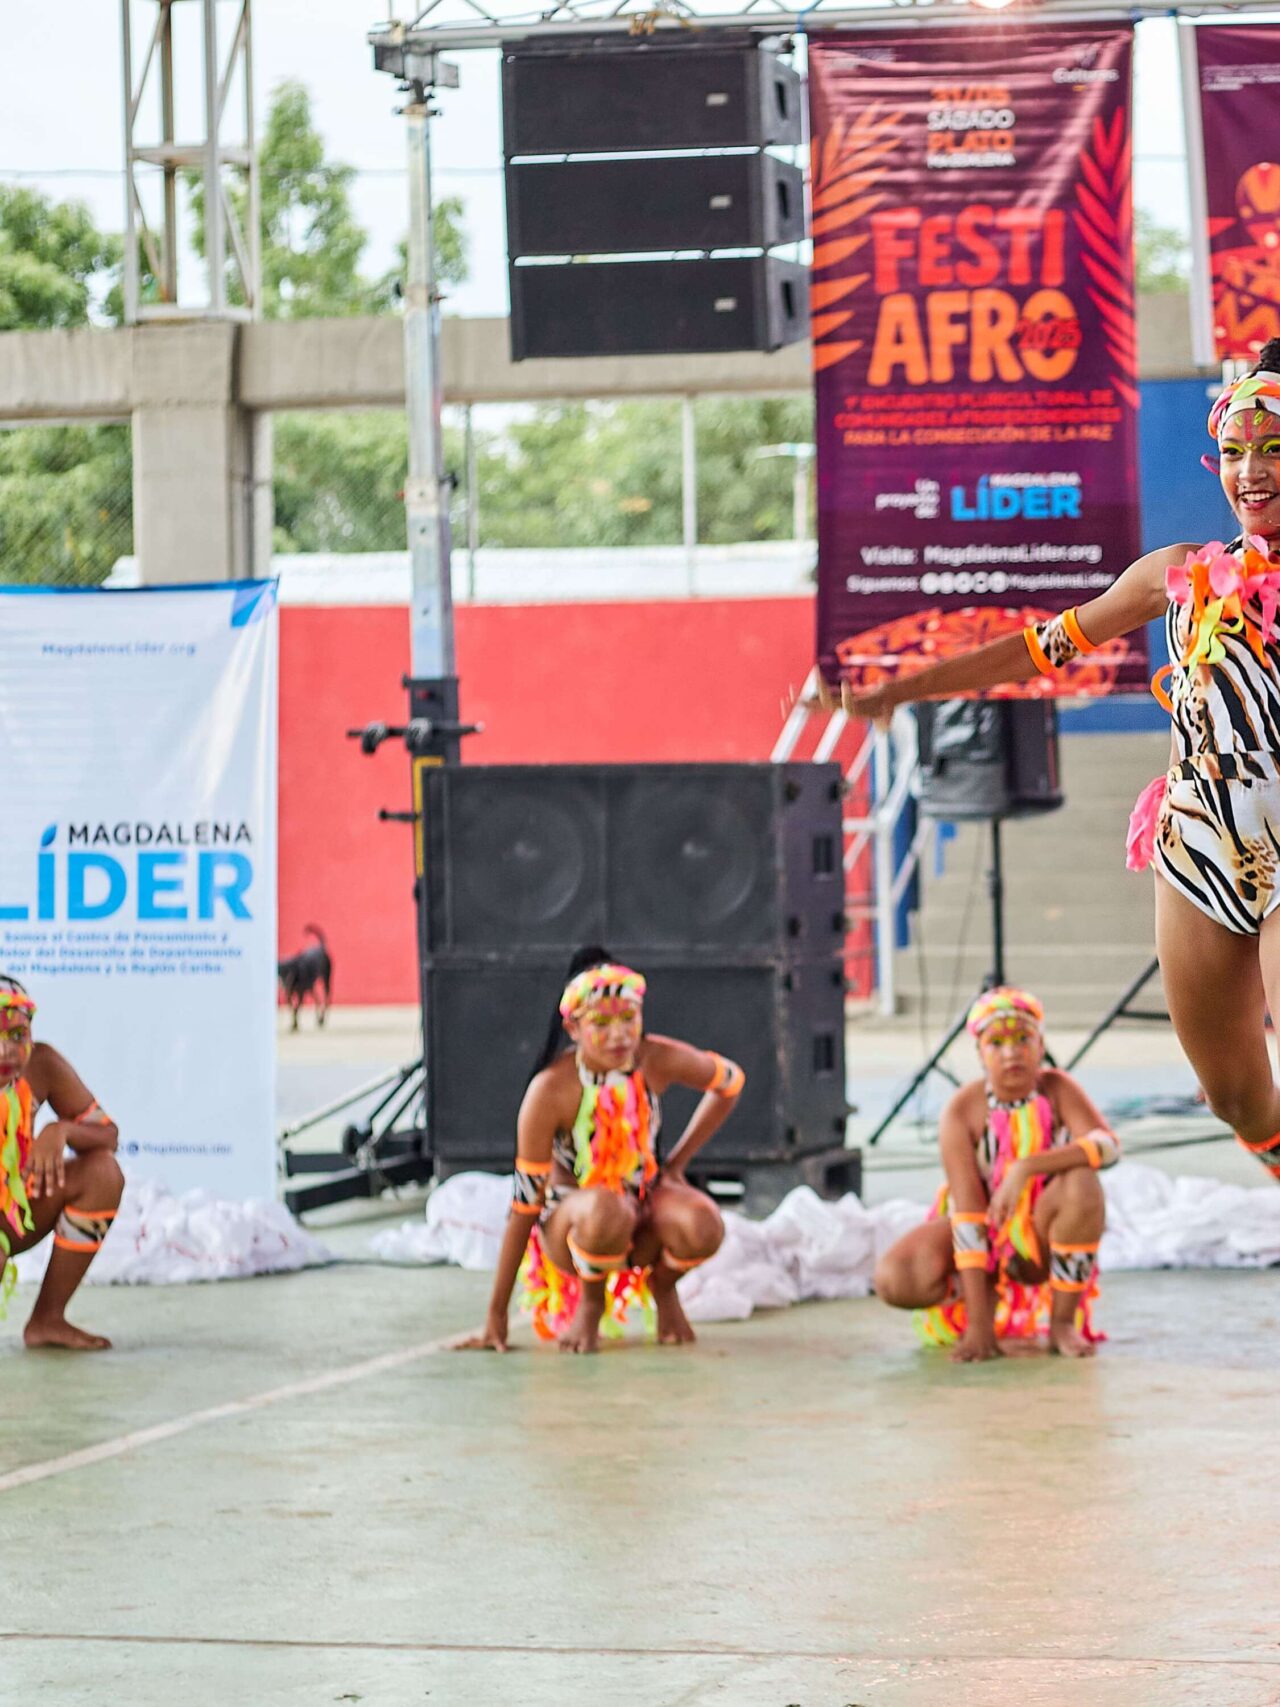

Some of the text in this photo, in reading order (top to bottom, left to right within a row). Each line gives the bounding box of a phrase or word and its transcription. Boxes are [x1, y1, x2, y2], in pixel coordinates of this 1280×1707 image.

[866, 289, 1079, 387] AFRO
[951, 474, 1083, 522] LÍDER
[68, 821, 253, 847] MAGDALENA
